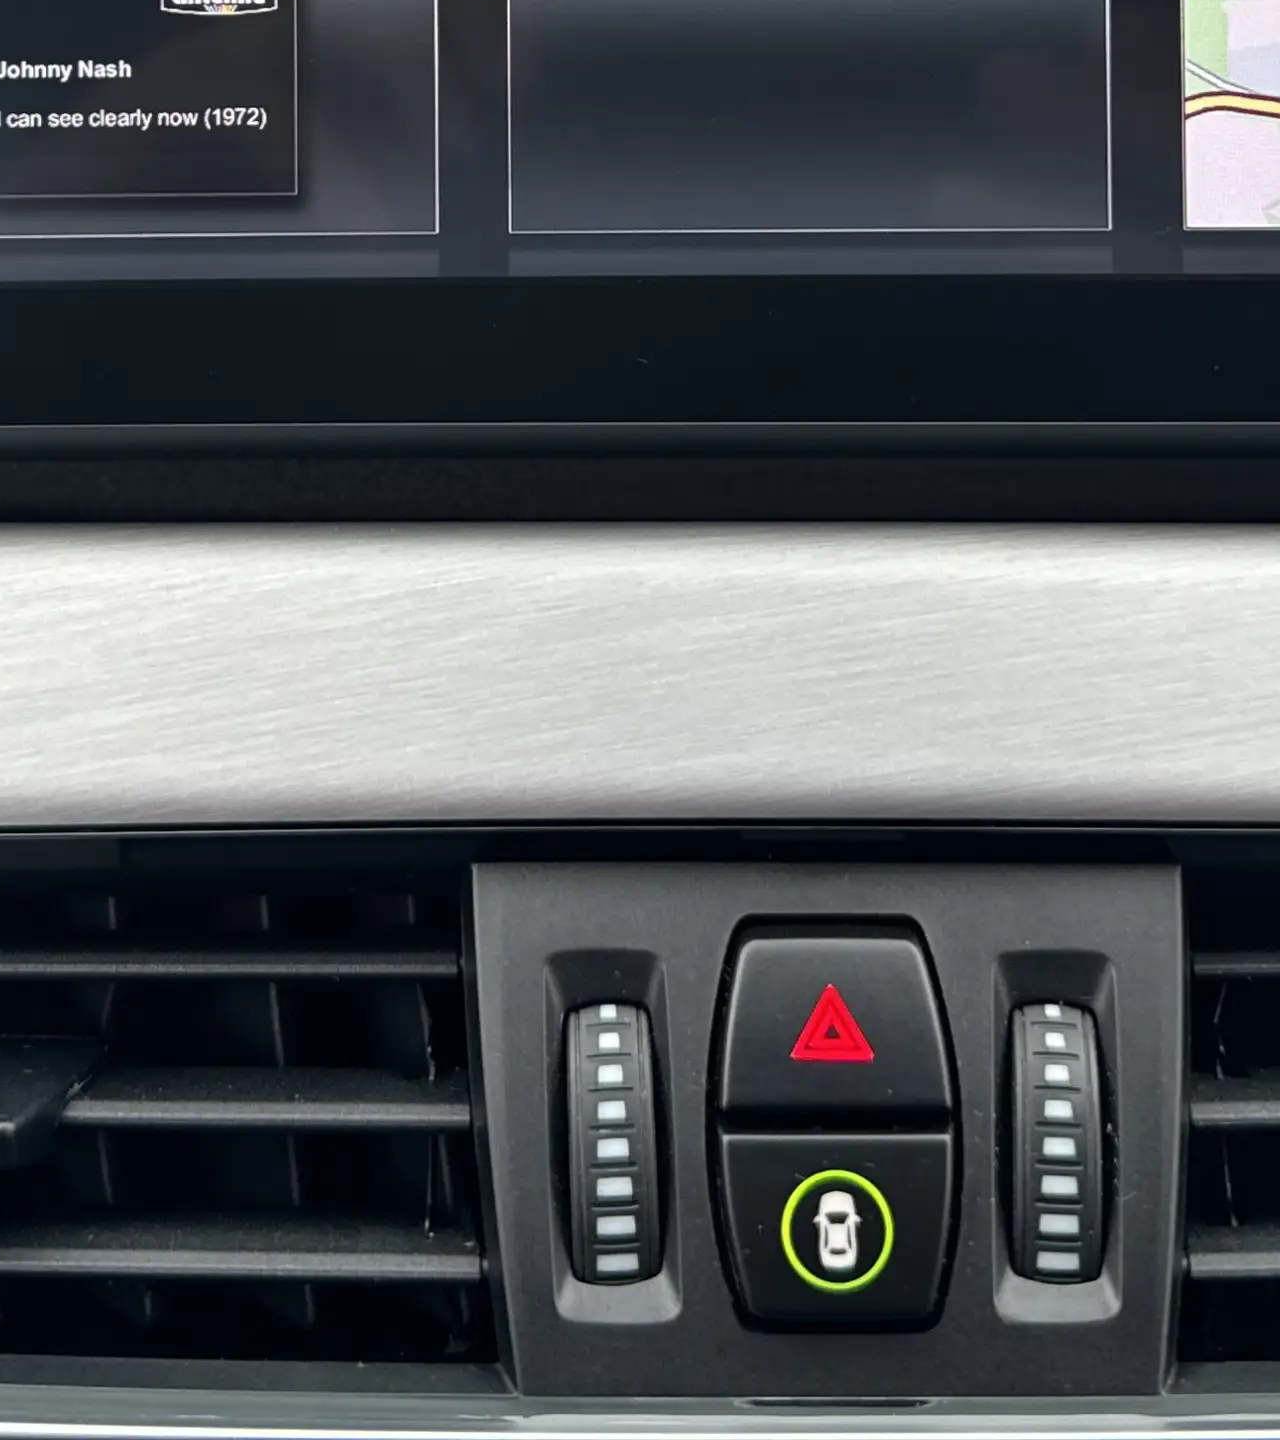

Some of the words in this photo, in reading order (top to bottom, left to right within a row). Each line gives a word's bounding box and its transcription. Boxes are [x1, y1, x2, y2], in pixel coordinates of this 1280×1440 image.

[77, 59, 133, 79] Nash
[5, 111, 43, 129] can
[46, 111, 85, 129] see
[87, 108, 154, 132] clearly
[156, 110, 200, 128] now
[202, 106, 268, 131] (1972)
